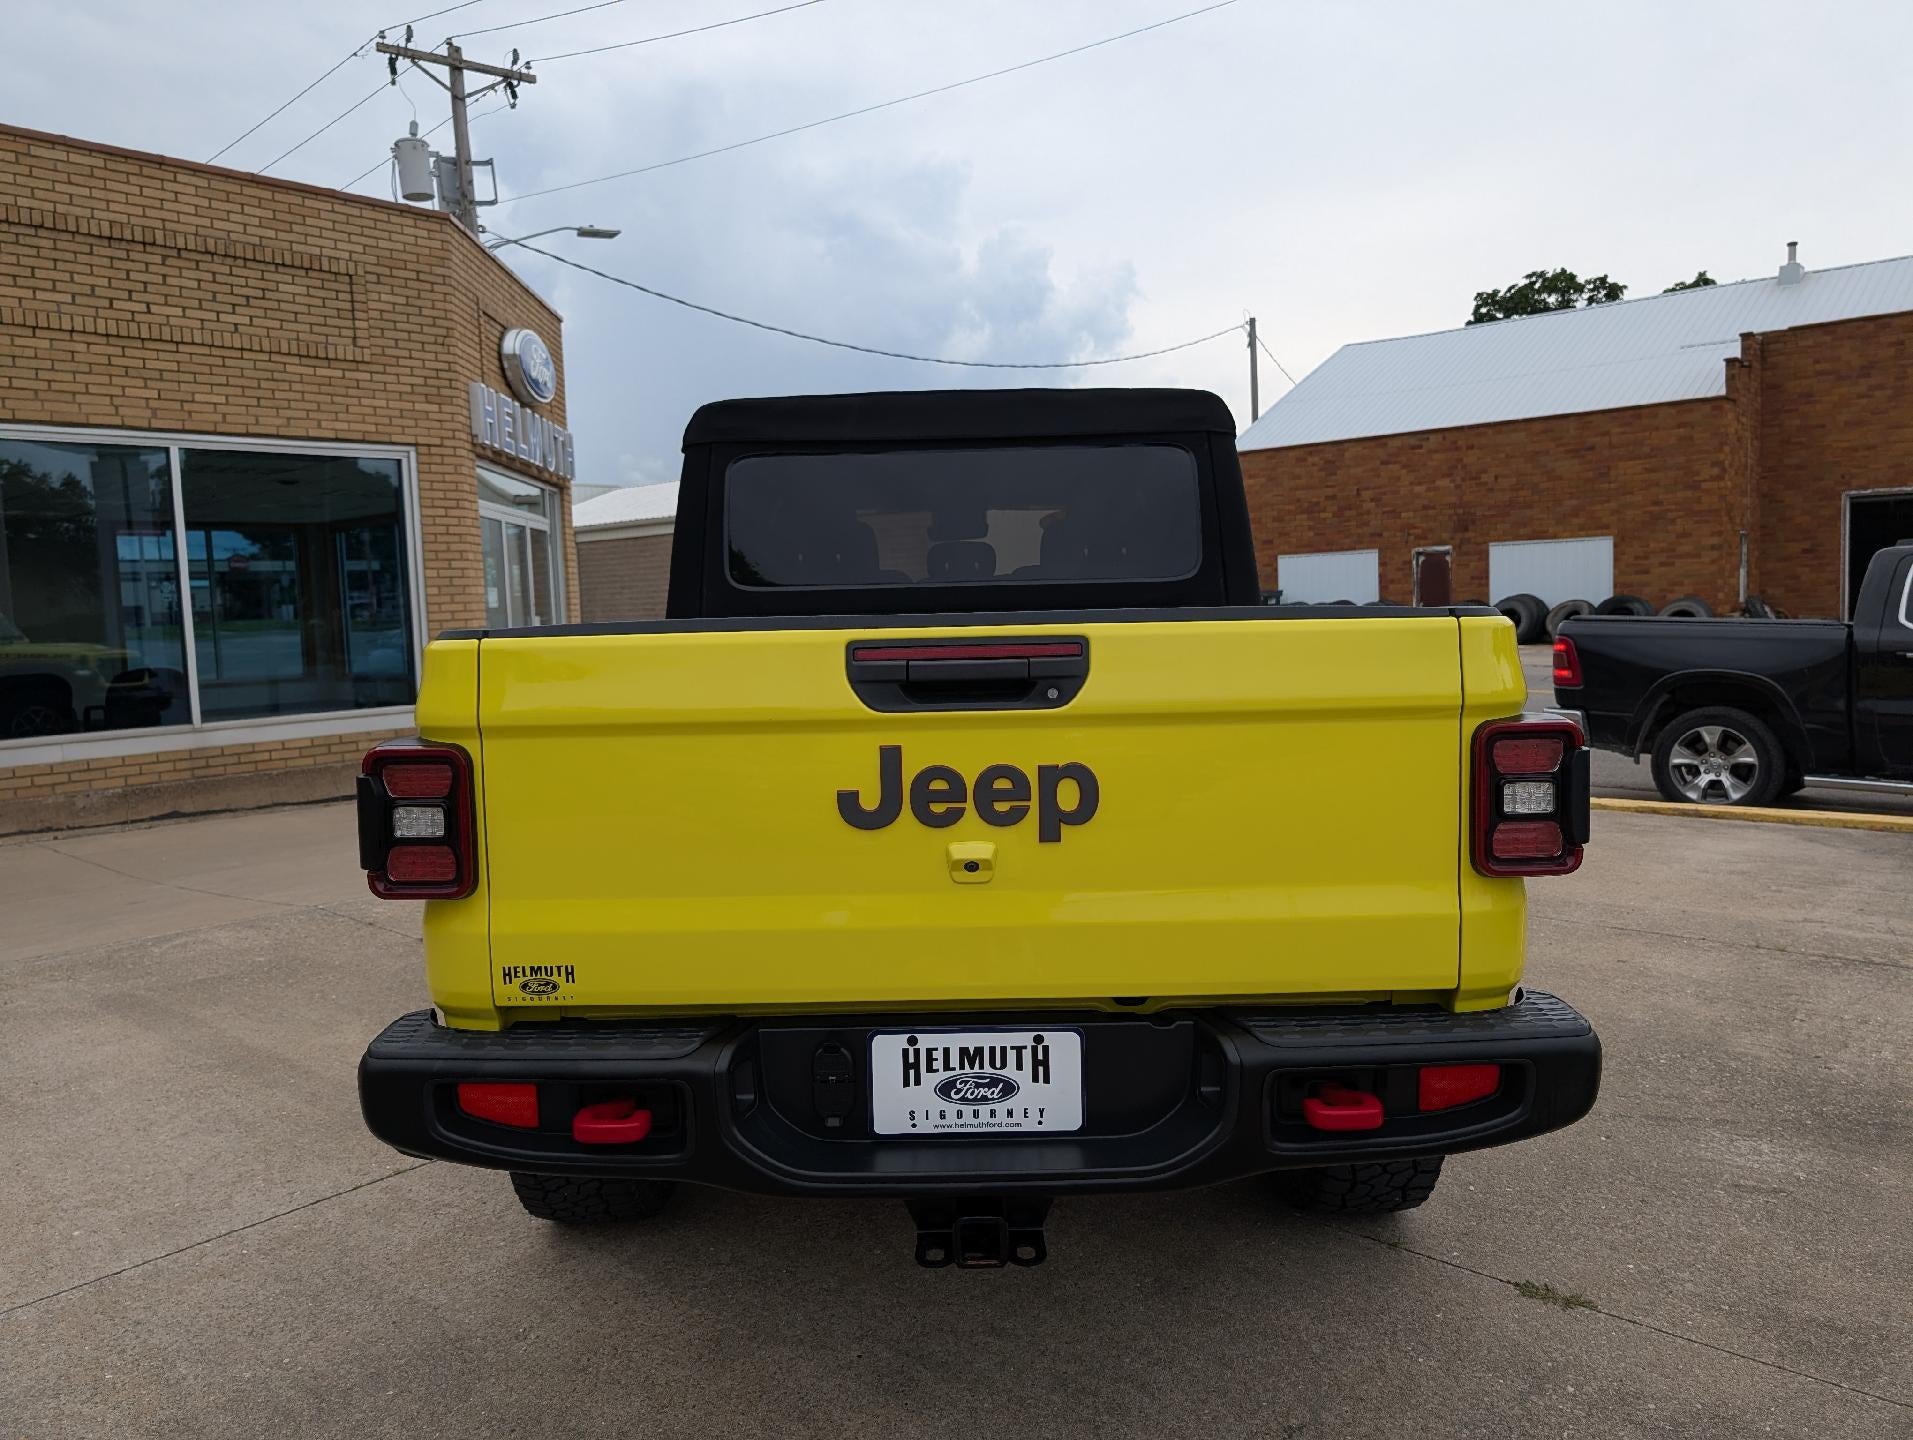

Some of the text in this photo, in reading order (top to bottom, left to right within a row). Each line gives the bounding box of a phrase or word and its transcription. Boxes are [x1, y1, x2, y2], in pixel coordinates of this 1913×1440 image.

[473, 383, 575, 480] HELMUTH
[837, 745, 1100, 843] Jeep
[502, 964, 575, 985] HELMUTH
[526, 981, 553, 992] Ford
[902, 1036, 1050, 1088] HELMUTH
[951, 1078, 1002, 1099] Ford
[908, 1107, 1046, 1122] SIGOURNEY
[933, 1121, 1022, 1129] www.helmuthford.com
